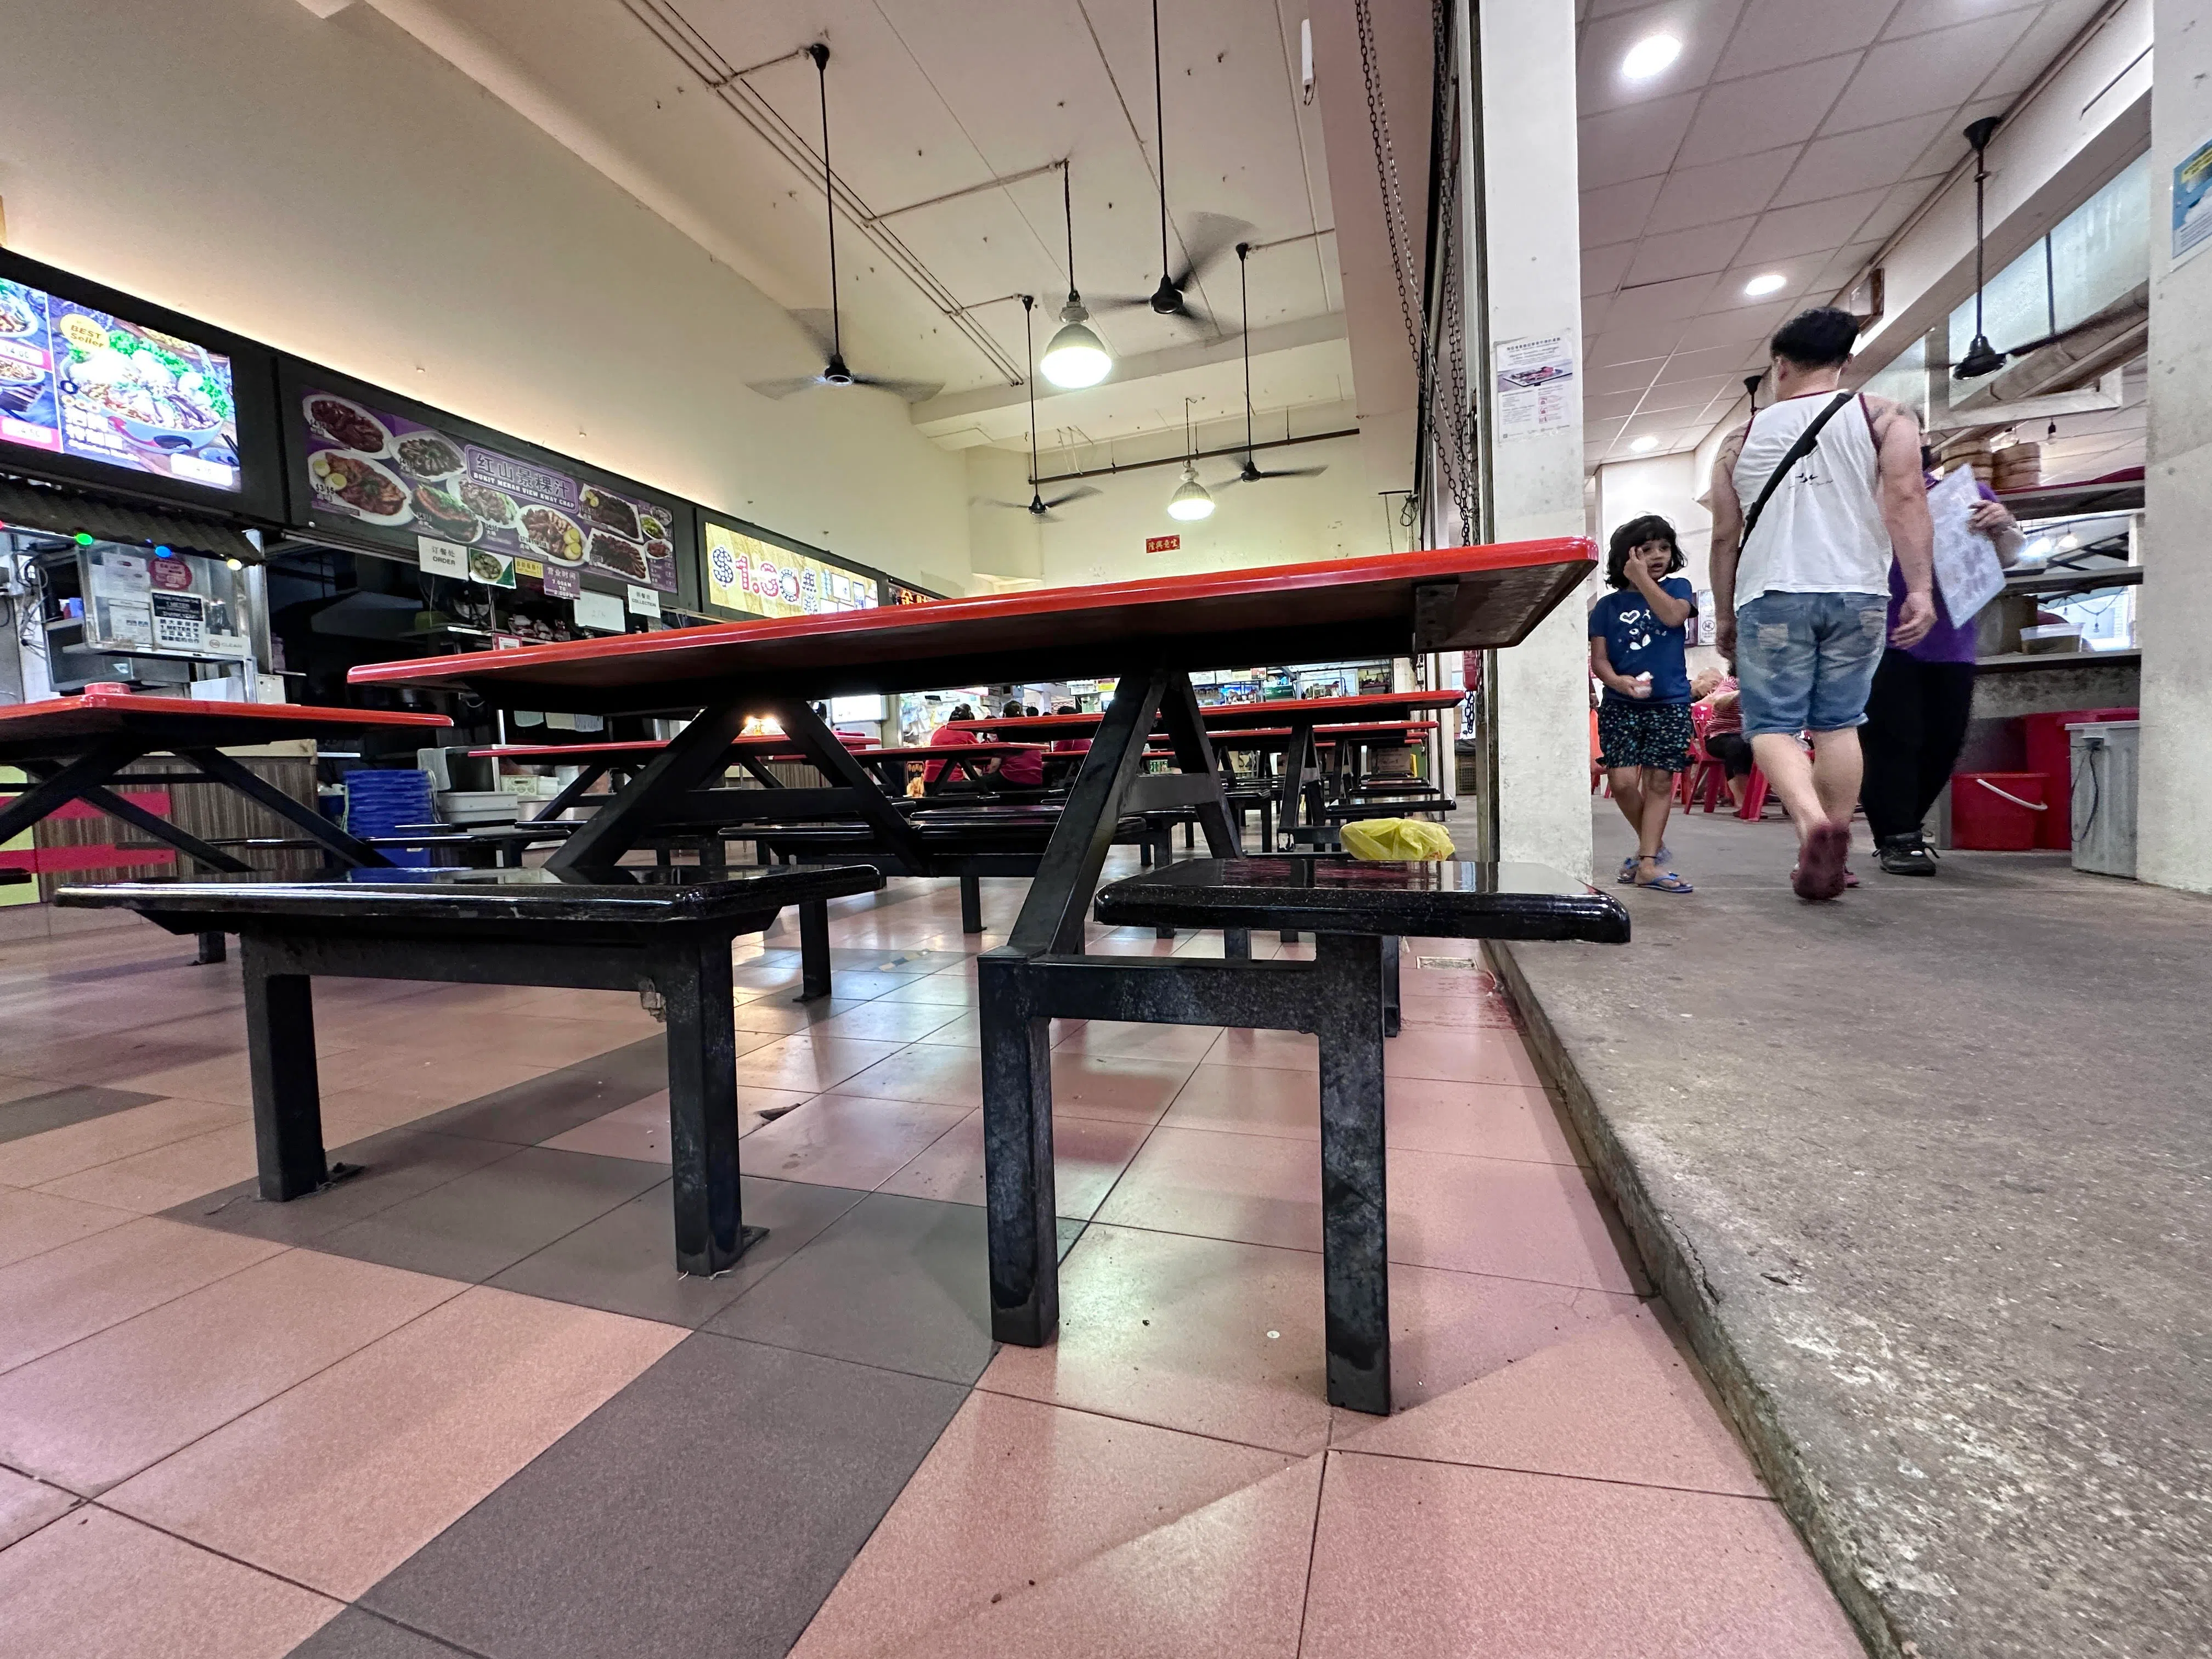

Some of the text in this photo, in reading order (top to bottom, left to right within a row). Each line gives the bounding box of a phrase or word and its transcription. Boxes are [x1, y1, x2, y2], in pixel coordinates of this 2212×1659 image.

[70, 324, 102, 339] BEST
[477, 453, 569, 499] 红山景粿汁
[473, 472, 575, 509] BUKIT MERAH VIEW KWAY CHAP
[431, 546, 456, 558] 订餐处
[432, 556, 456, 566] ORDER
